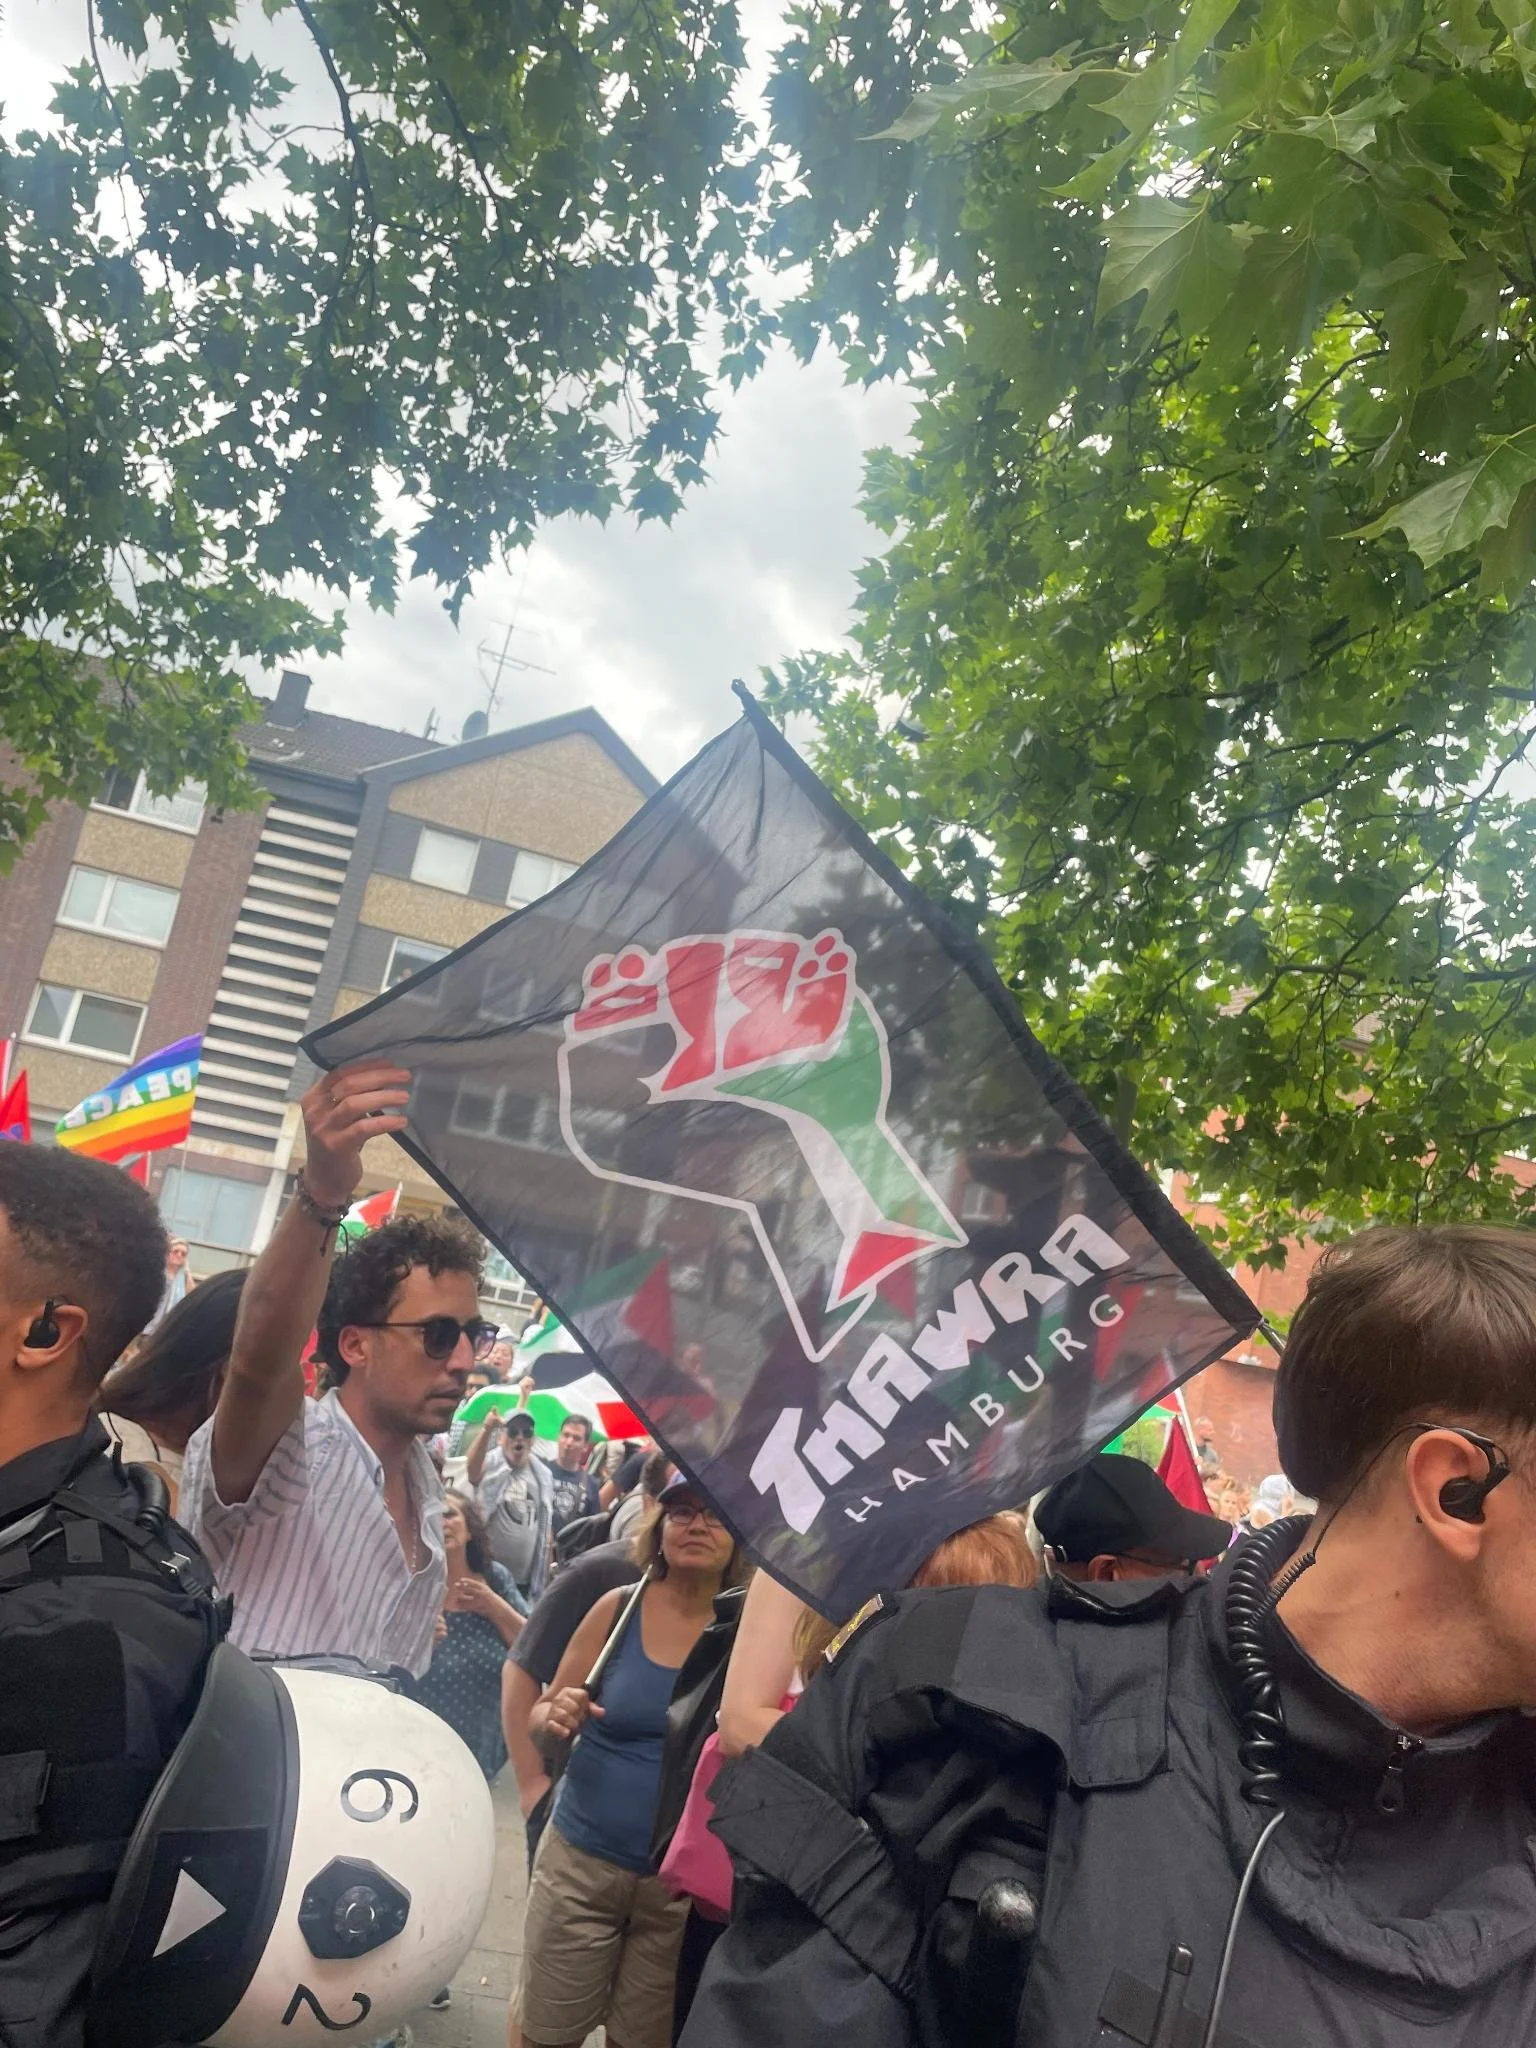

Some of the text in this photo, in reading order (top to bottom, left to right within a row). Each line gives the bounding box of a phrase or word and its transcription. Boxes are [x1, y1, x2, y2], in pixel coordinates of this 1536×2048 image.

[749, 1214, 1130, 1535] THAWRA
[844, 1294, 1124, 1523] HAMBURG
[281, 1984, 371, 2031] 2
